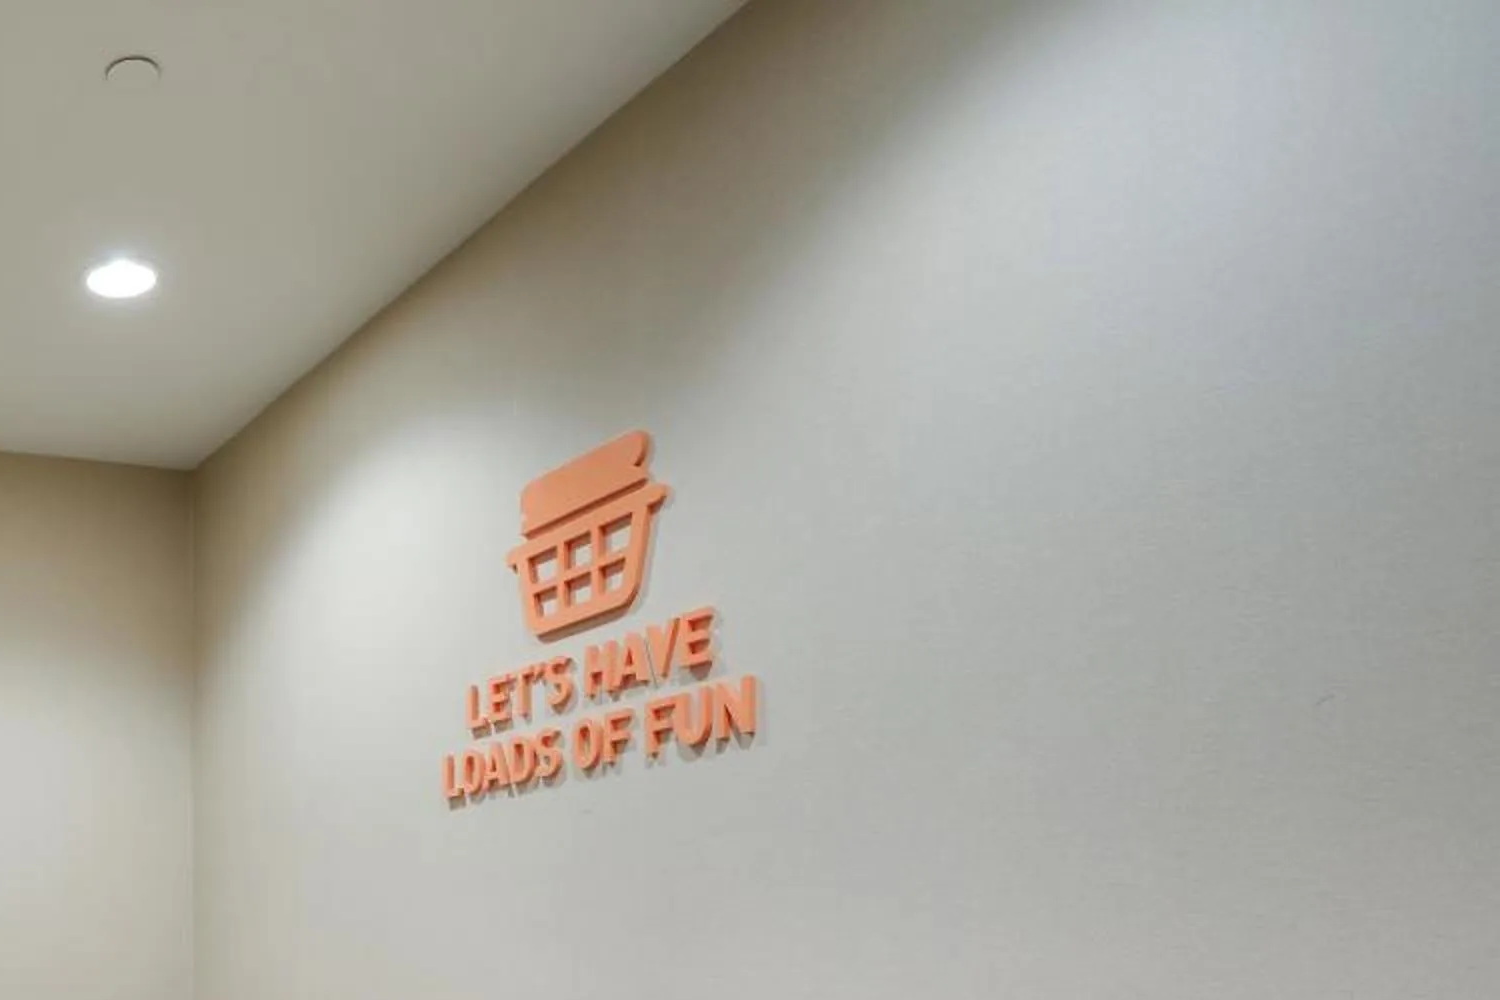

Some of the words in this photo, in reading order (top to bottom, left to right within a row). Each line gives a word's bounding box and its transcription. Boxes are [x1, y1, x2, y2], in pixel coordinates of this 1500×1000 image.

[466, 657, 574, 733] LET'S
[584, 607, 716, 698] HAVE
[442, 730, 562, 802] LOADS
[573, 709, 634, 769] OF
[645, 674, 757, 758] FUN
